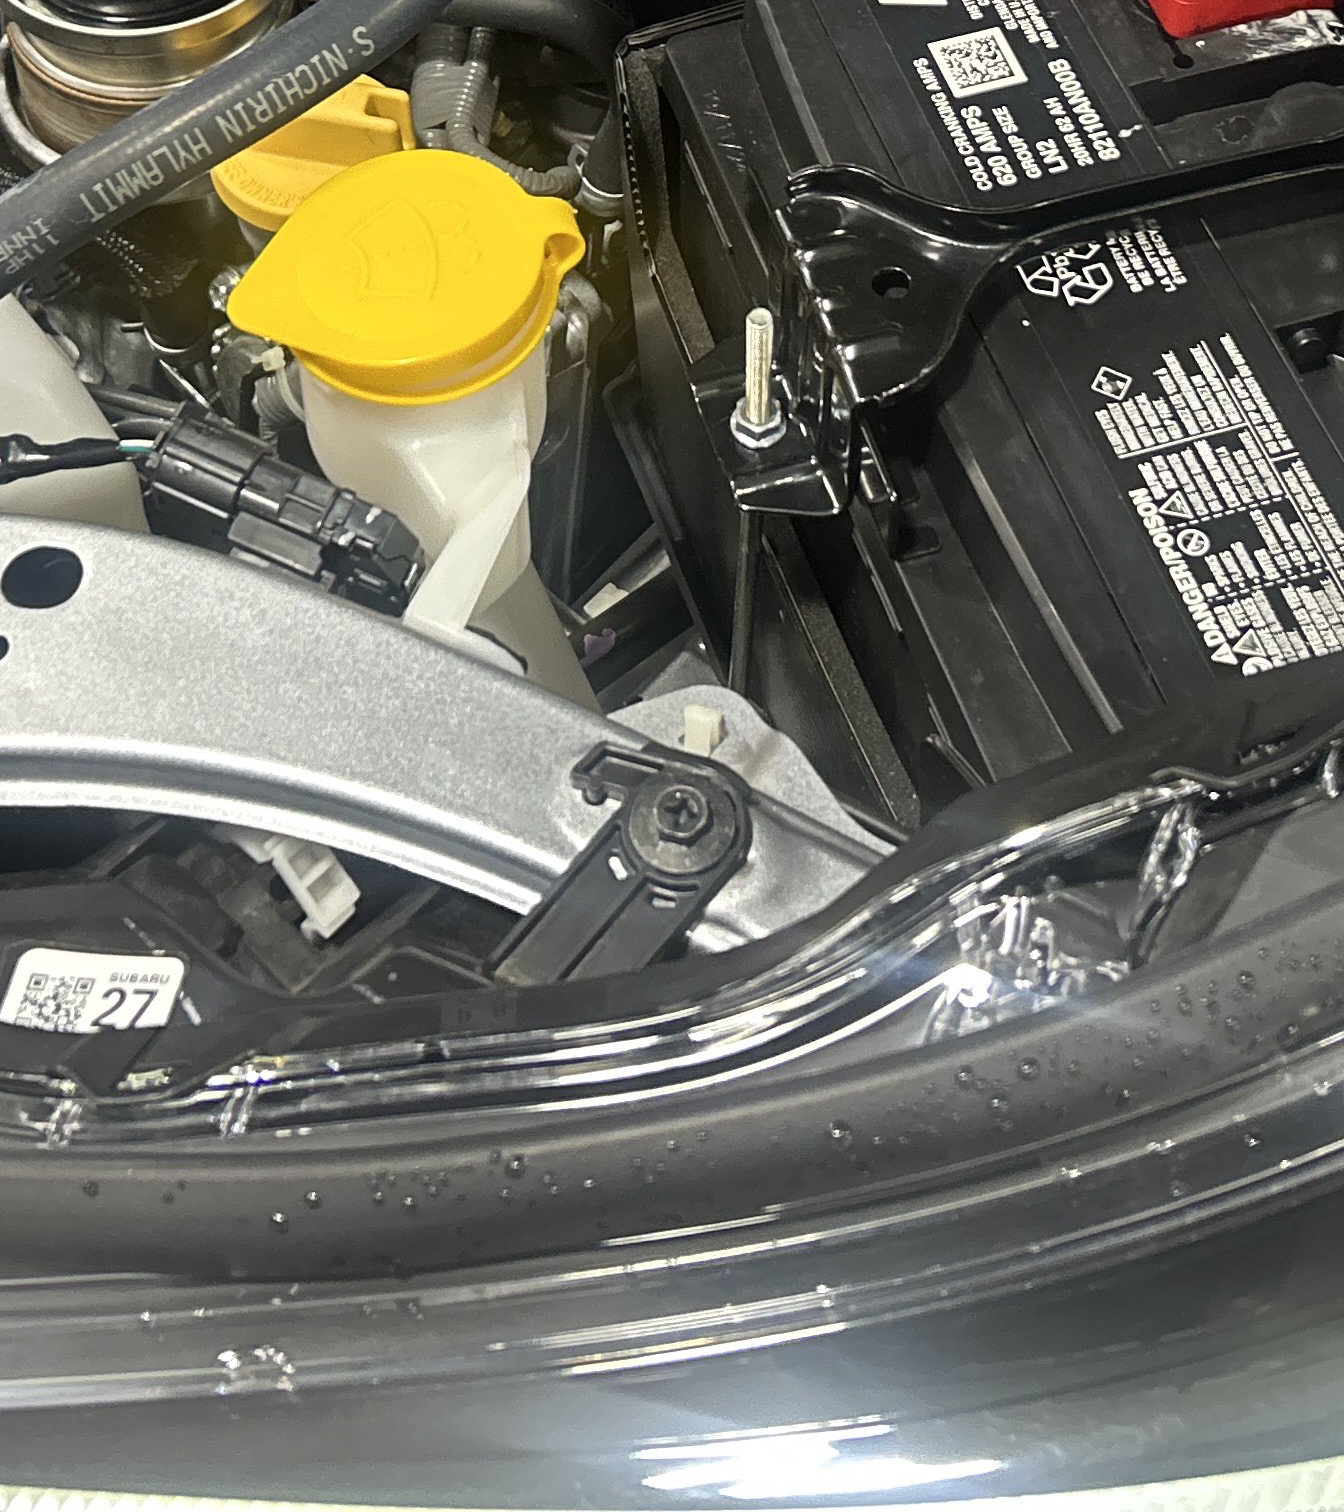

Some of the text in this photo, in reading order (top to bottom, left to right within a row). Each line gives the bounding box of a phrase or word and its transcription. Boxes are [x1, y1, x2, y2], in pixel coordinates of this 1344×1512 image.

[1012, 8, 1025, 18] IN
[1017, 17, 1039, 43] MADE
[1038, 29, 1059, 49] AND
[910, 57, 993, 191] COLD CRANKING AMPS
[1045, 57, 1121, 162] 82110AN00B
[958, 104, 1018, 187] 620 AMPS
[991, 105, 1043, 179] GROUP SIZE
[1043, 96, 1094, 167] 20HR 62 AH
[72, 122, 213, 226] HYLAMMIT
[1033, 138, 1068, 174] LN2
[1, 231, 60, 276] 11HP
[1053, 255, 1076, 281] Pb
[1109, 247, 1143, 292] BATTERY
[1117, 235, 1145, 269] RECYC
[1159, 277, 1176, 291] LA
[1304, 510, 1319, 522] OF
[1127, 486, 1226, 645] DANGER/POISON
[109, 972, 171, 985] SUBARU
[90, 987, 159, 1027] 27
